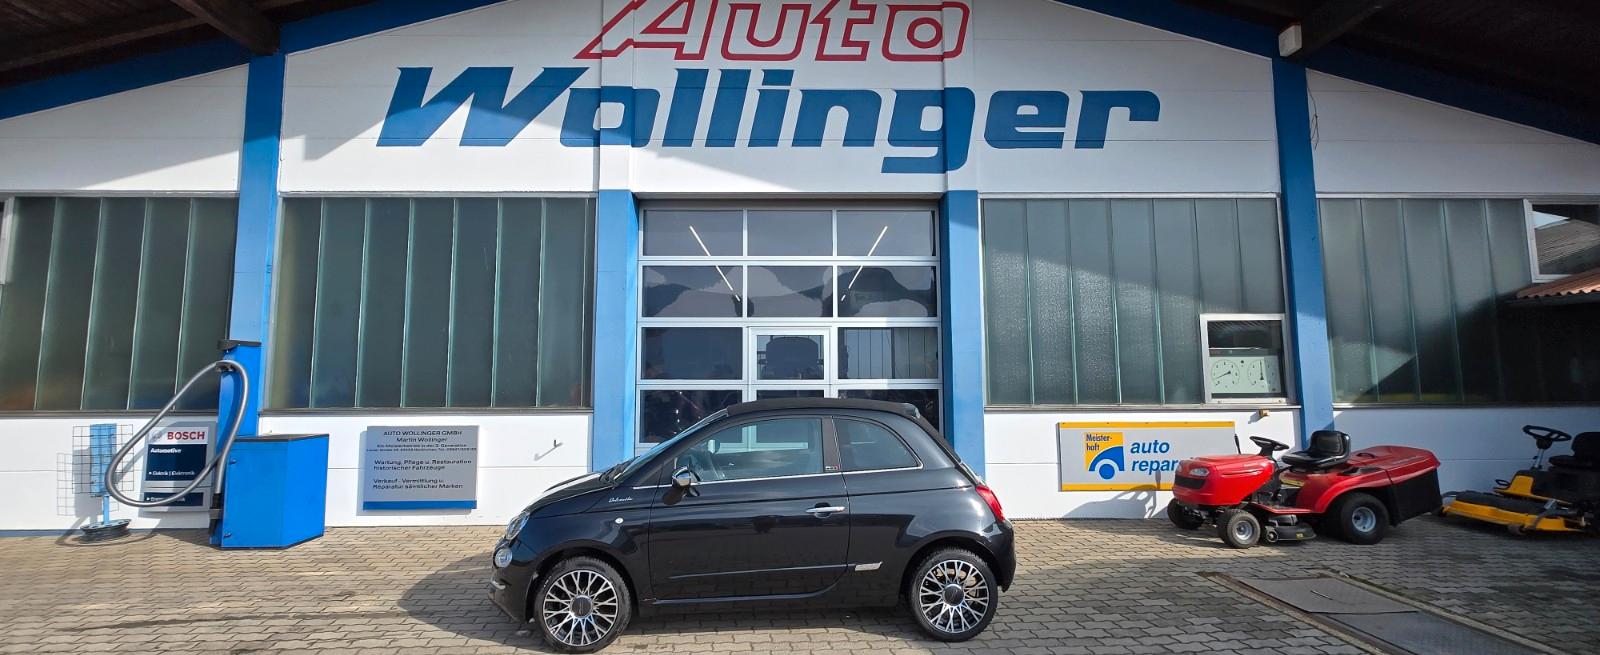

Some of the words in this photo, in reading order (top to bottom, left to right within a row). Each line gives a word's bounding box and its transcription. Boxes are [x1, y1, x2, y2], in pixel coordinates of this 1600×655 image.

[573, 0, 969, 62] Auto
[376, 66, 1160, 174] Wollinger
[167, 431, 205, 440] BOSCH
[1086, 434, 1113, 442] Meister-
[1130, 440, 1170, 454] auto
[1131, 459, 1179, 476] repar
